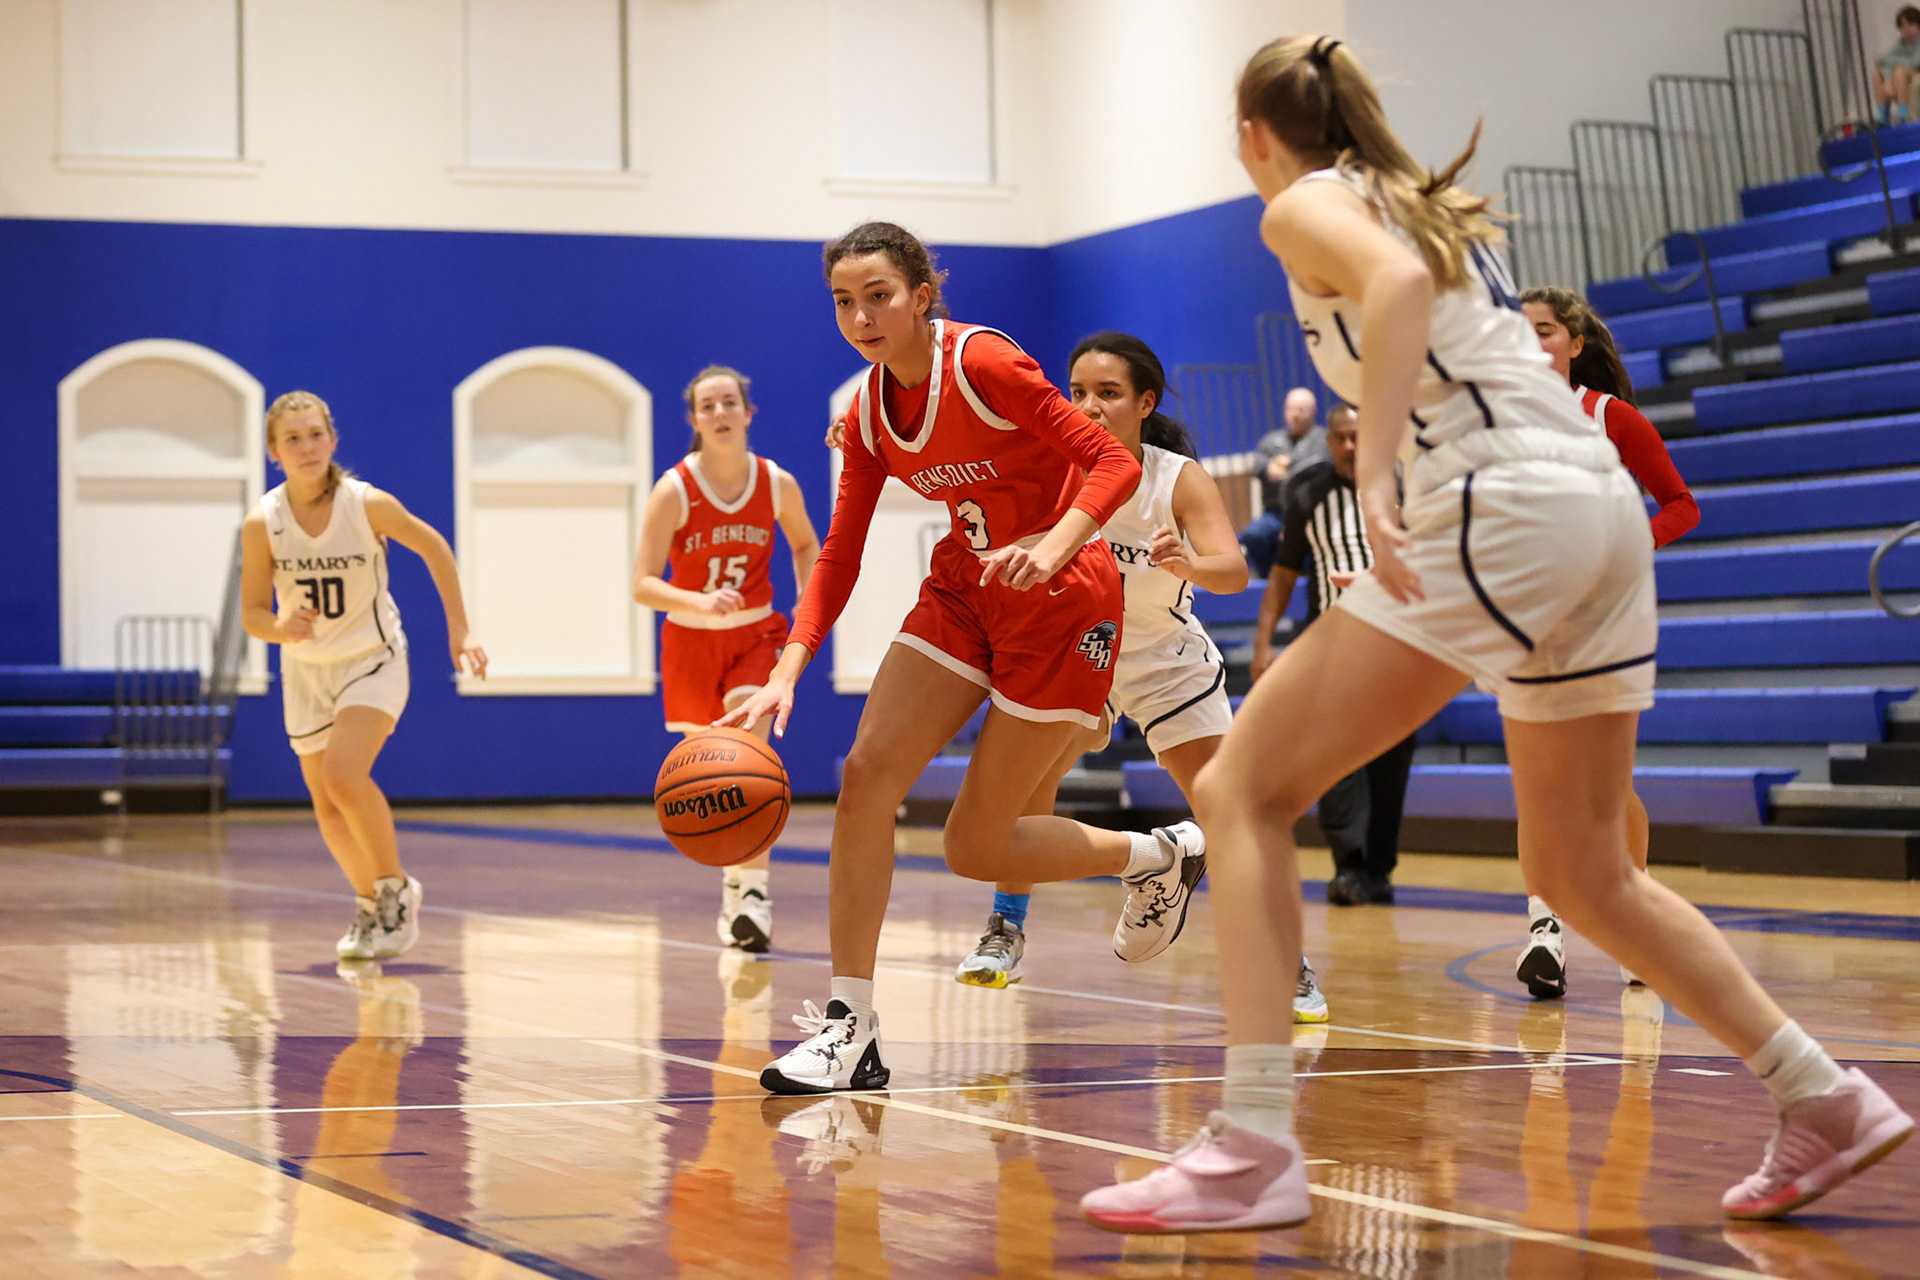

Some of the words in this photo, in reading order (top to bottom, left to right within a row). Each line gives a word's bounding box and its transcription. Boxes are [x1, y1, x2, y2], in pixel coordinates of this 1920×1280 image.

[910, 460, 998, 494] BENEDICT
[955, 499, 990, 551] 3
[685, 532, 708, 554] ST.
[275, 559, 293, 571] T.
[297, 554, 366, 571] MARY'S
[703, 555, 748, 593] 15
[295, 577, 345, 619] 30
[1079, 632, 1111, 669] SBA
[661, 749, 736, 780] EVOLUTION
[663, 785, 747, 819] Wilson
